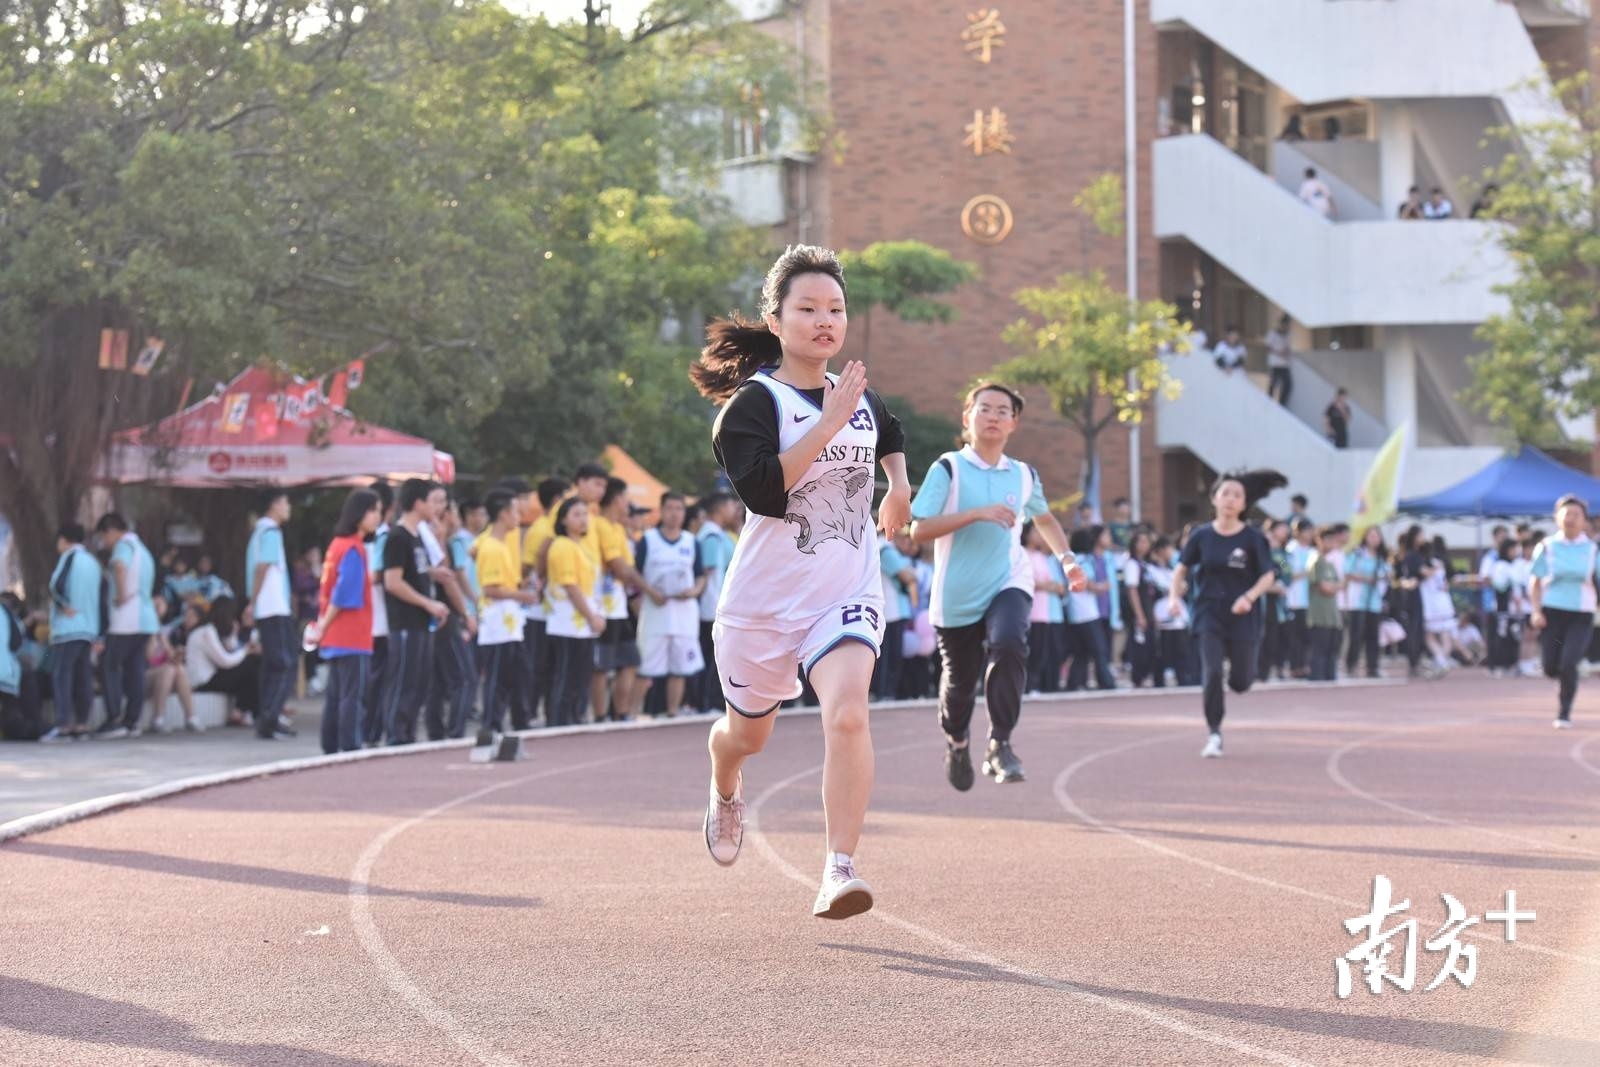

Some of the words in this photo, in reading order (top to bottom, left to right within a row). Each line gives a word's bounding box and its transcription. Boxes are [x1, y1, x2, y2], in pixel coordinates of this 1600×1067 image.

[848, 408, 874, 431] 23
[852, 445, 875, 465] TE
[841, 604, 879, 632] 23
